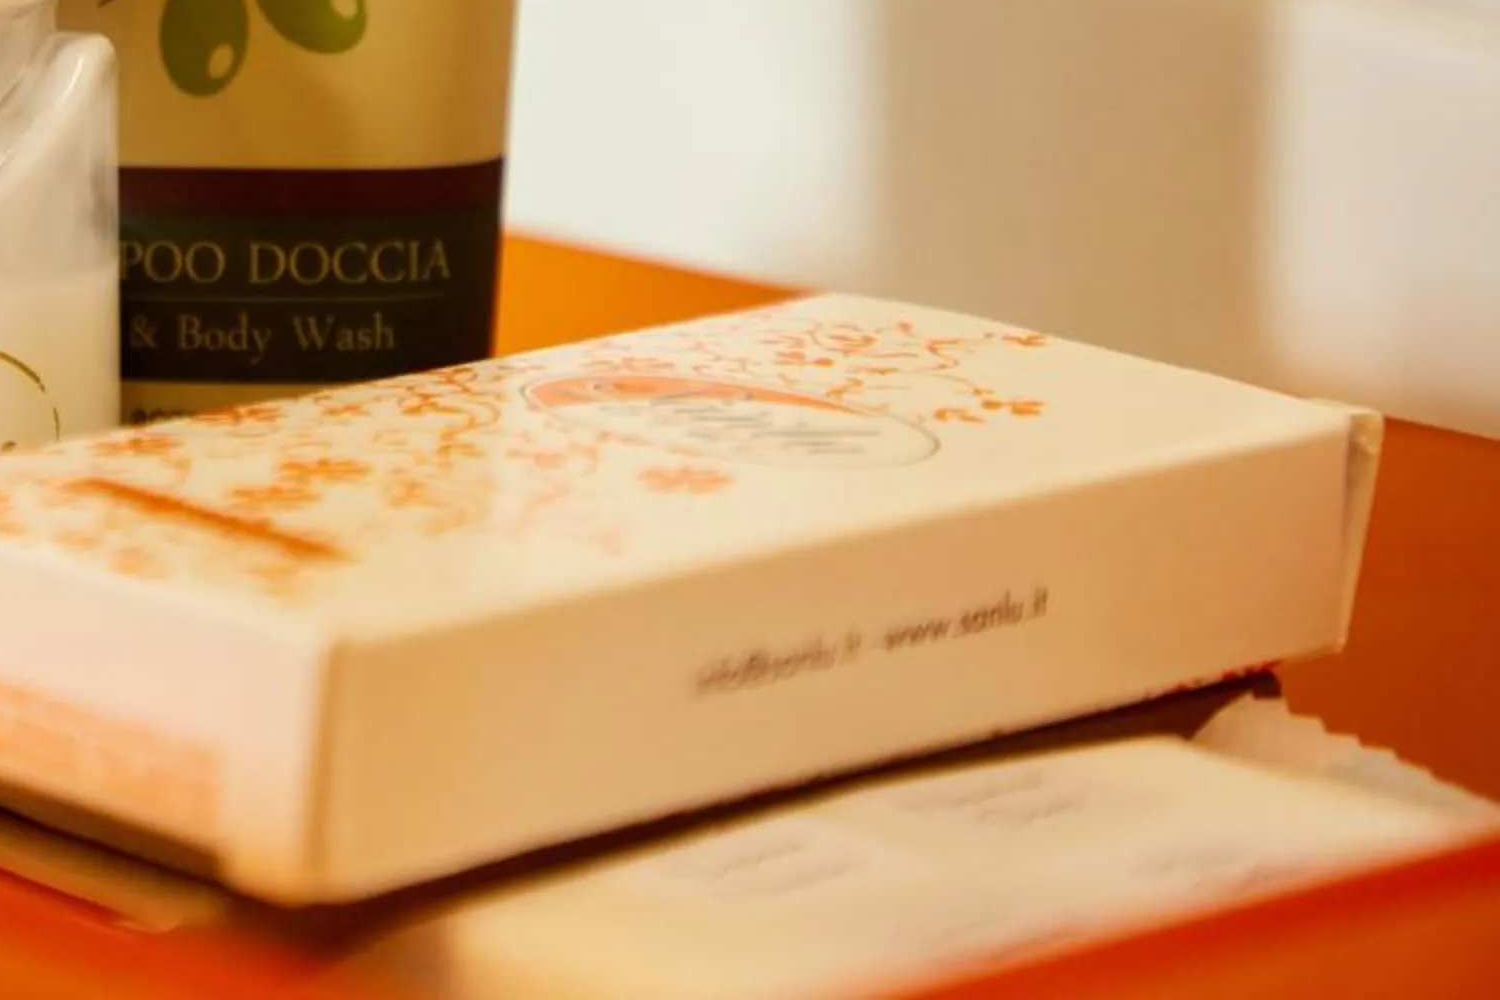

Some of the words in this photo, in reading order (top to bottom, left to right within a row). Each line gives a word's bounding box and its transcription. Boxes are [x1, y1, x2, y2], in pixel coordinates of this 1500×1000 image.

[119, 239, 227, 285] POO
[248, 239, 451, 285] DOCCIA
[130, 313, 158, 350] &
[177, 311, 272, 366] Body
[291, 311, 396, 352] Wash
